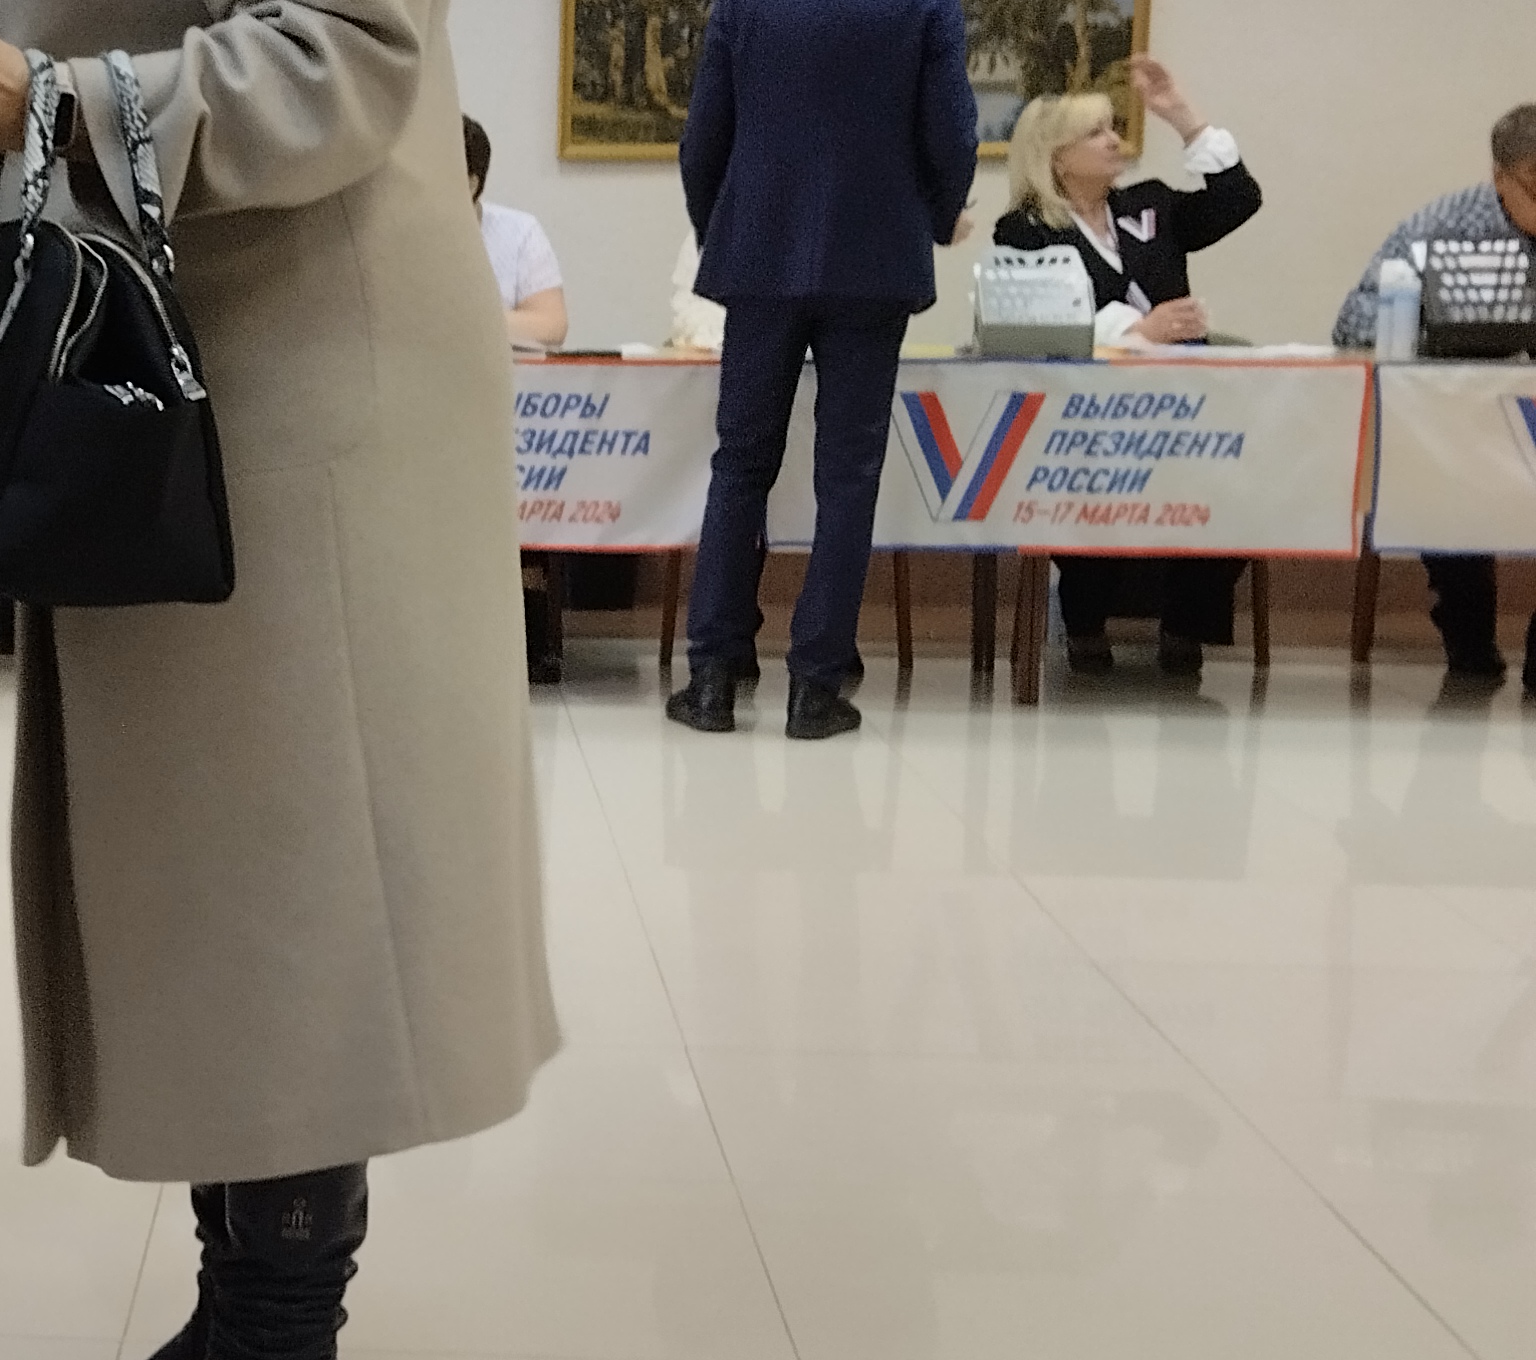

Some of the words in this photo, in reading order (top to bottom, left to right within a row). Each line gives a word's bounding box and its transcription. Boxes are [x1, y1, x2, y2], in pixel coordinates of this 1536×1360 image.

[1062, 392, 1207, 421] ВЫБОРЫ
[1043, 429, 1245, 461] ПРЕЗИДЕНТА
[1025, 465, 1154, 494] РОССИИ
[568, 500, 622, 523] 2024
[1075, 502, 1151, 525] МАРТА
[1155, 503, 1211, 526] 2024
